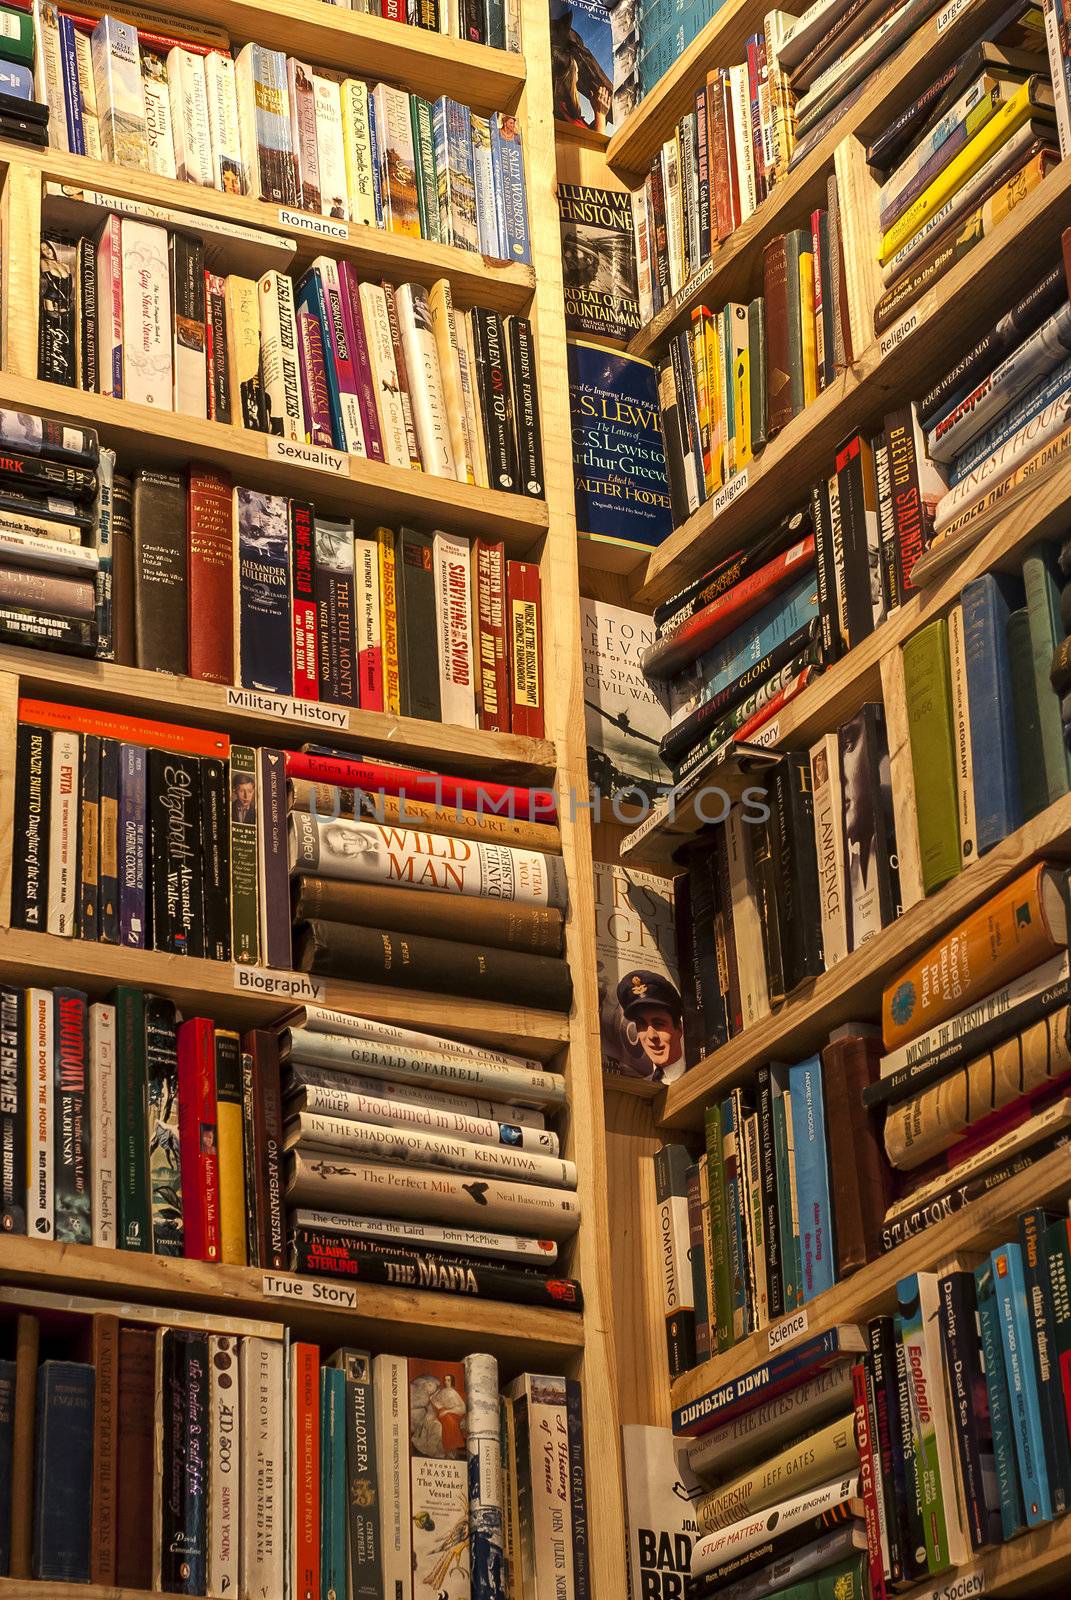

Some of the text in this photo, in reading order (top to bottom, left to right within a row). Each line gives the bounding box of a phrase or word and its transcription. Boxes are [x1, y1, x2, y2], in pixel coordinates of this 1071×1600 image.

[937, 0, 962, 29] Large
[145, 84, 160, 148] Jacobs
[158, 101, 166, 129] Anna
[508, 148, 525, 241] SALLY WORBOYES
[558, 183, 608, 203] ILLIAM
[281, 212, 347, 238] Romance
[561, 201, 633, 231] HNSTONE
[676, 265, 713, 303] Westerns
[879, 248, 953, 318] Handbook to the Bible
[276, 275, 300, 419] LISA ALTHER KINFLICKS
[486, 316, 500, 368] WOMEN
[881, 315, 917, 353] Religion
[491, 370, 502, 391] ON
[493, 395, 505, 420] TOP
[601, 400, 664, 432] LEWI
[278, 443, 342, 469] Sexuality
[574, 450, 668, 482] rthur Greev
[605, 434, 648, 459] Lewis
[650, 446, 665, 462] to
[626, 486, 671, 508] HOOPE
[715, 474, 747, 511] Religion
[241, 568, 286, 586] FULLERTON
[242, 560, 286, 576] ALEXANDER
[449, 562, 467, 629] SURVIVING
[338, 582, 352, 699] THE FULL MONTY
[525, 604, 537, 704] NURSE AT THE RUSSIAN FRONT
[452, 639, 470, 686] SWORD
[739, 656, 772, 688] GLORY
[228, 693, 346, 724] Military History
[586, 678, 660, 706] CIVIL WAR
[679, 746, 709, 775] ABRAHAM
[959, 721, 968, 779] GEOGRAPHY
[30, 735, 43, 818] BENAZIR BHUTTO
[60, 766, 72, 794] EVITA
[160, 764, 194, 859] Elizabeth
[303, 815, 315, 862] palgrave
[376, 826, 472, 862] WILD
[488, 846, 500, 897] DANIEL
[501, 846, 513, 901] ELLSBERG
[521, 861, 530, 889] TOM
[533, 858, 545, 897] WELLS
[821, 807, 841, 920] LAWRENCE
[167, 872, 176, 917] Walker
[181, 865, 195, 930] Alexander
[239, 971, 319, 995] Biography
[941, 946, 949, 1000] Animal
[951, 937, 963, 999] Biology
[317, 1010, 508, 1064] children in exile THEKLA CLARK
[938, 1022, 951, 1045] THE
[987, 998, 997, 1019] OF
[998, 990, 1011, 1015] LIFE
[351, 1050, 483, 1083] GERALD O'FARRELL
[39, 1108, 47, 1142] HOUSE
[357, 1098, 493, 1138] Proclaimed in Blood
[311, 1120, 324, 1130] IN
[328, 1122, 351, 1136] THE
[354, 1130, 404, 1146] SHADOW
[408, 1139, 422, 1149] OF
[434, 1143, 466, 1158] SAINT
[474, 1150, 498, 1163] KEN
[500, 1155, 536, 1170] WIWA
[39, 1170, 47, 1210] MEZRICH
[267, 1140, 283, 1253] ON AFGHANISTAN
[362, 1170, 555, 1208] The Perfect Mile Neal Bascomb
[312, 1214, 499, 1246] The Crofter and the Laird John McPhee
[883, 1186, 970, 1250] STATION X
[660, 1206, 676, 1306] COMPUTING
[264, 1276, 356, 1304] True Story
[384, 1260, 478, 1292] THE MAFIA
[769, 1316, 804, 1346] Science
[944, 1282, 967, 1427] Dancing Dead Sea
[259, 1352, 268, 1440] DEE BROWN
[680, 1368, 769, 1426] DUMBING DOWN
[908, 1345, 931, 1423] Ecologic
[352, 1387, 368, 1473] PHYLLOXERA
[856, 1404, 868, 1447] RED
[417, 1479, 464, 1490] The Weaker
[420, 1469, 460, 1478] FRASER
[702, 1450, 815, 1520] OWNERSHIP JEFF GATES
[428, 1490, 452, 1498] Vessel
[701, 1493, 831, 1556] STUFF MATTERS HARRY BINGHAM
[638, 1528, 692, 1572] BAD
[944, 1575, 984, 1600] Society
